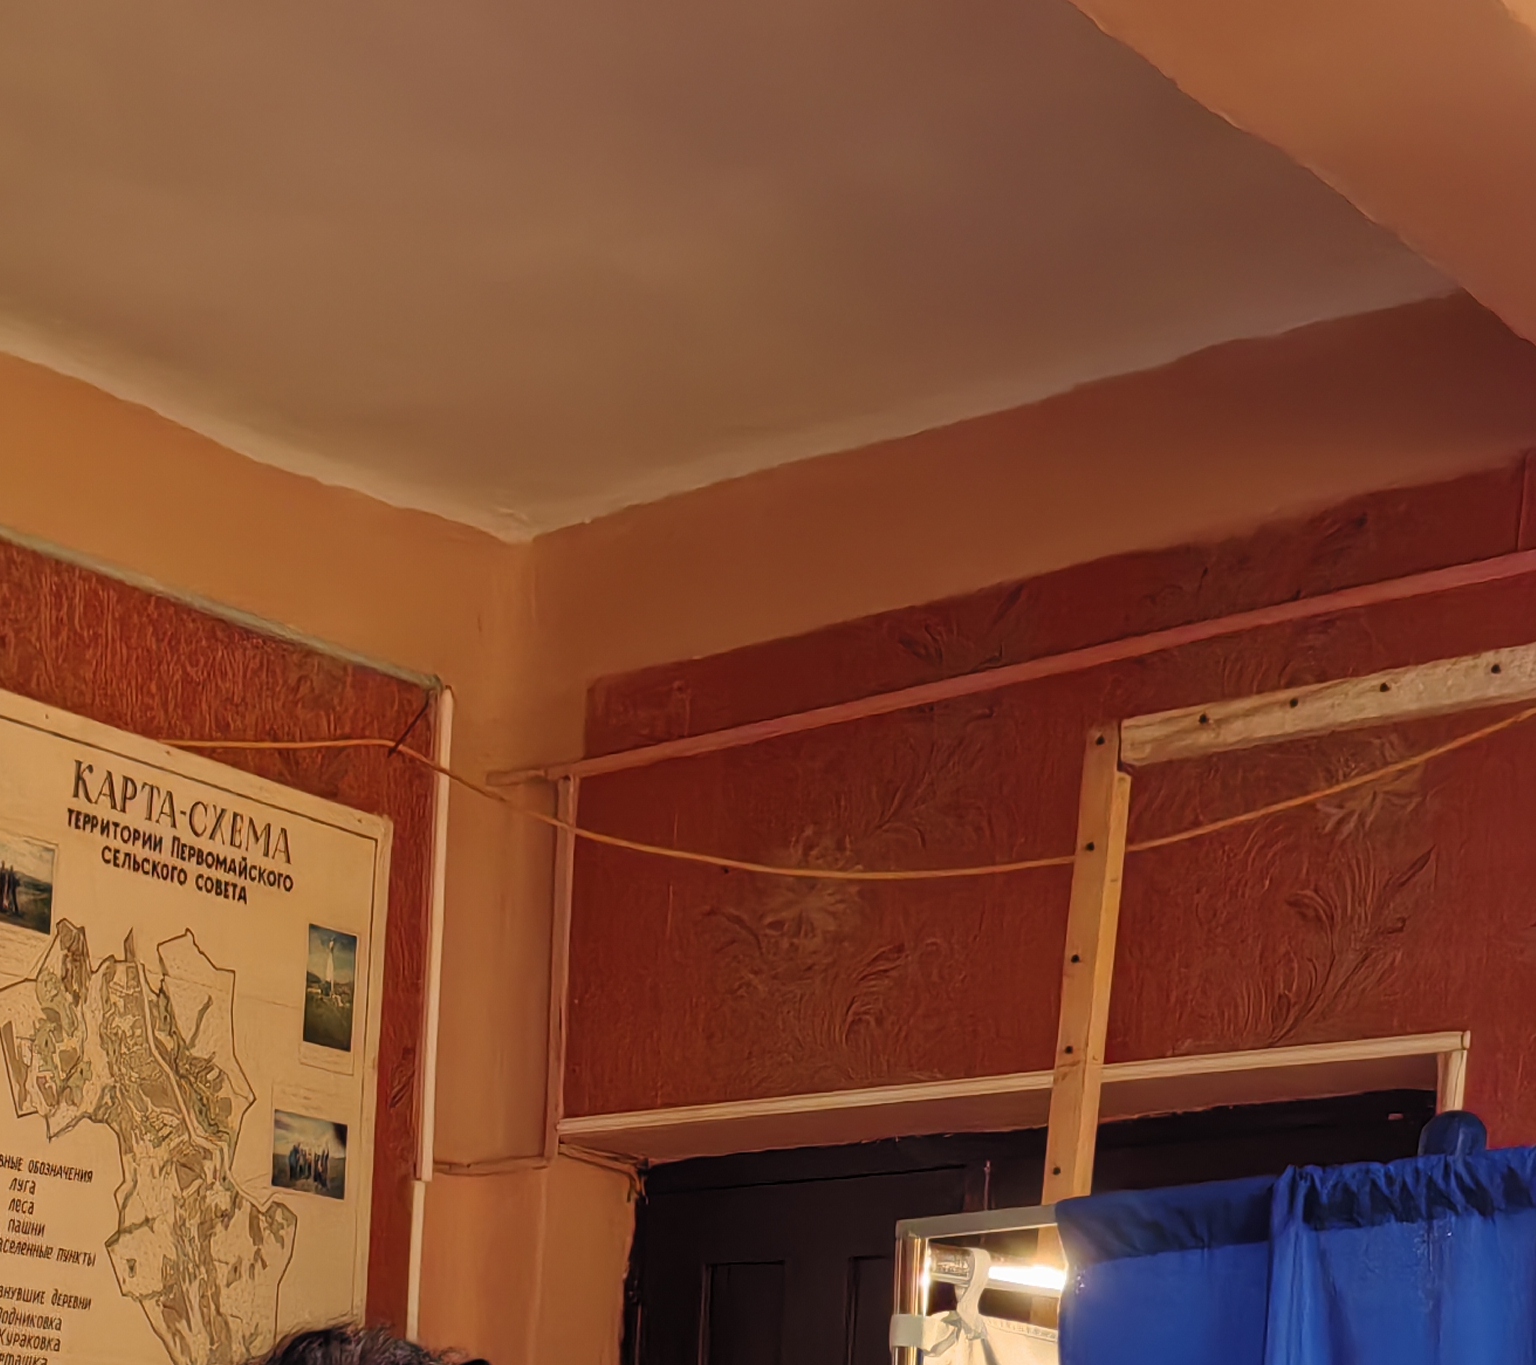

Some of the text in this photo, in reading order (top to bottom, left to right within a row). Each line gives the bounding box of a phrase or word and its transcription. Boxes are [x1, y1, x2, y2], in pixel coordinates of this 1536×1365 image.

[67, 807, 163, 854] ТЕРРИТОРИИ
[72, 759, 292, 865] КАРТА-СХЕМА
[101, 845, 248, 905] СЕЛЬСКОГО СОВЕТА
